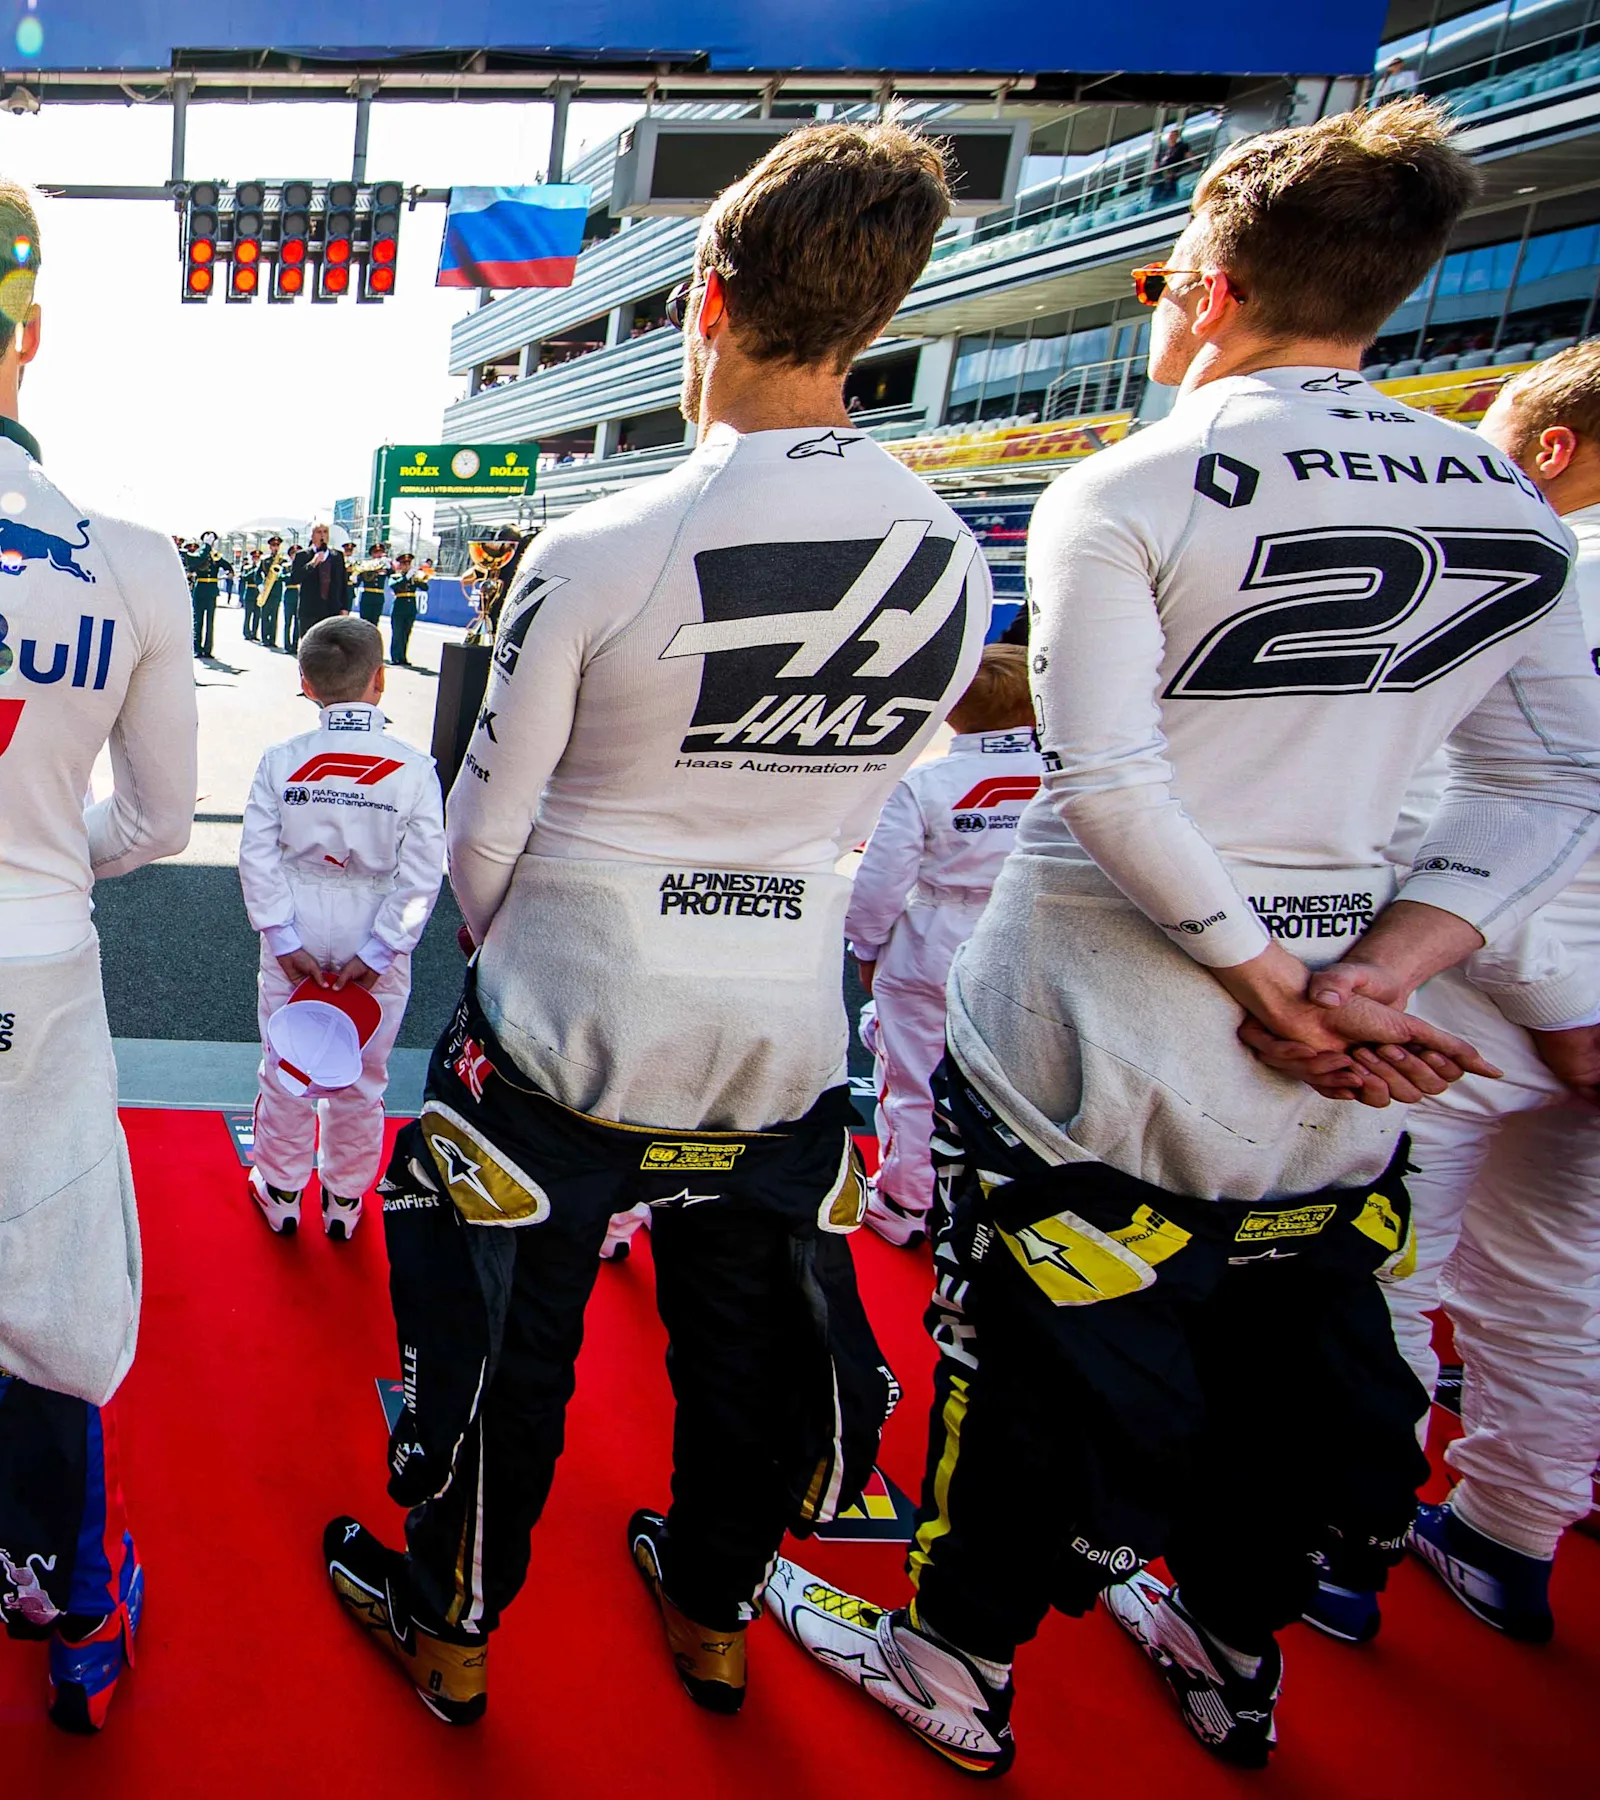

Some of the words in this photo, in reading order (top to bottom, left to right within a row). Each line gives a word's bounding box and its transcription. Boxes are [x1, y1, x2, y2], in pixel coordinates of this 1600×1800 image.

[400, 466, 440, 476] ROLEX
[489, 466, 530, 476] ROLEX
[1161, 525, 1572, 700] 27
[688, 695, 931, 747] HAAS
[674, 759, 733, 769] Haas
[739, 760, 858, 774] Automation
[863, 762, 887, 772] Inc
[285, 790, 307, 803] FIA
[327, 790, 359, 799] Formula
[337, 798, 393, 812] Championship
[956, 818, 984, 830] FIA
[1451, 862, 1491, 878] Ross
[660, 873, 806, 895] ALPINESTARS
[660, 892, 802, 920] PROTECTS
[1203, 910, 1227, 928] Bell
[404, 1344, 417, 1414] MILLE
[1071, 1536, 1110, 1566] Bell
